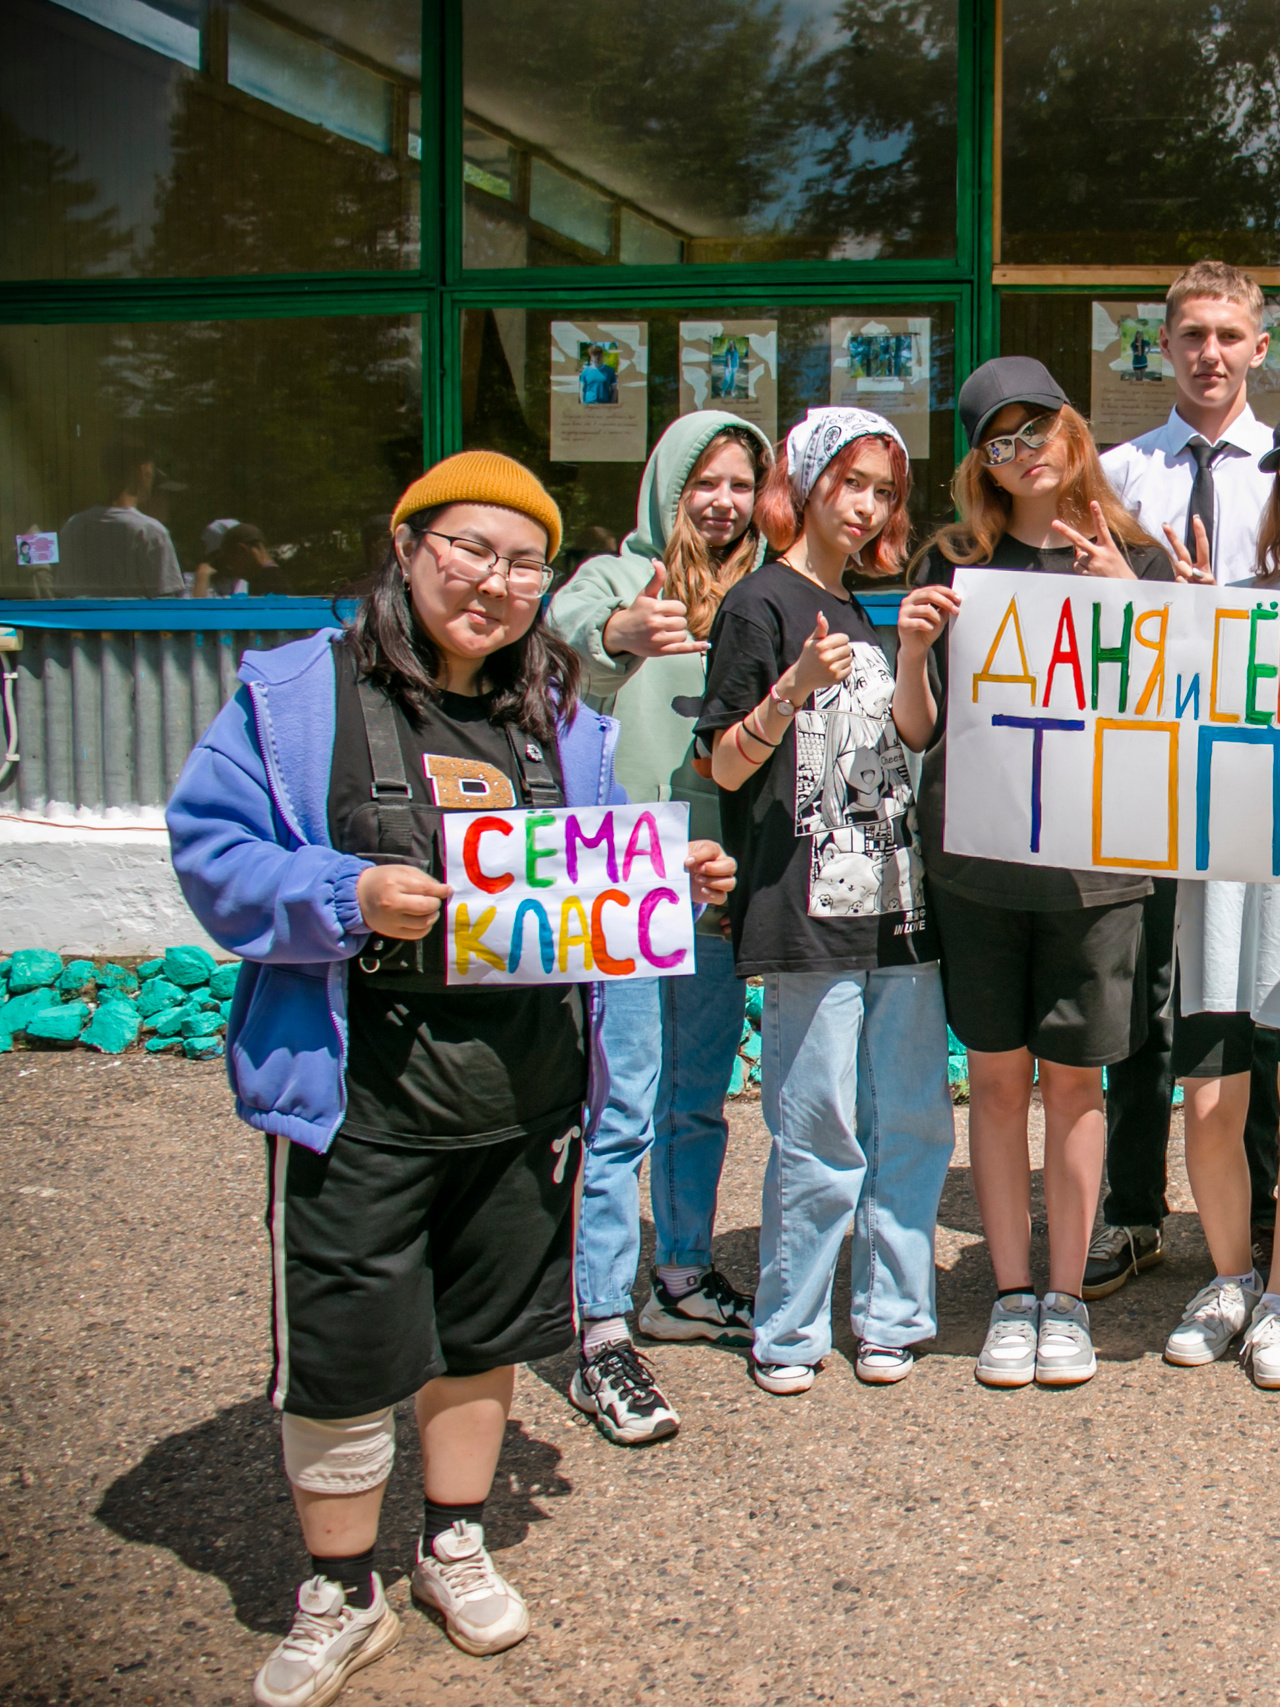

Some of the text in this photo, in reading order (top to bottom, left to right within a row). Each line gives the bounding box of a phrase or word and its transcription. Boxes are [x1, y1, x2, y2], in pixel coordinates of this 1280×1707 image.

[972, 596, 1172, 716] ДАНЯ
[463, 810, 667, 894] СЁМА
[455, 887, 687, 976] КЛАСС
[893, 919, 926, 936] IN LOVE
